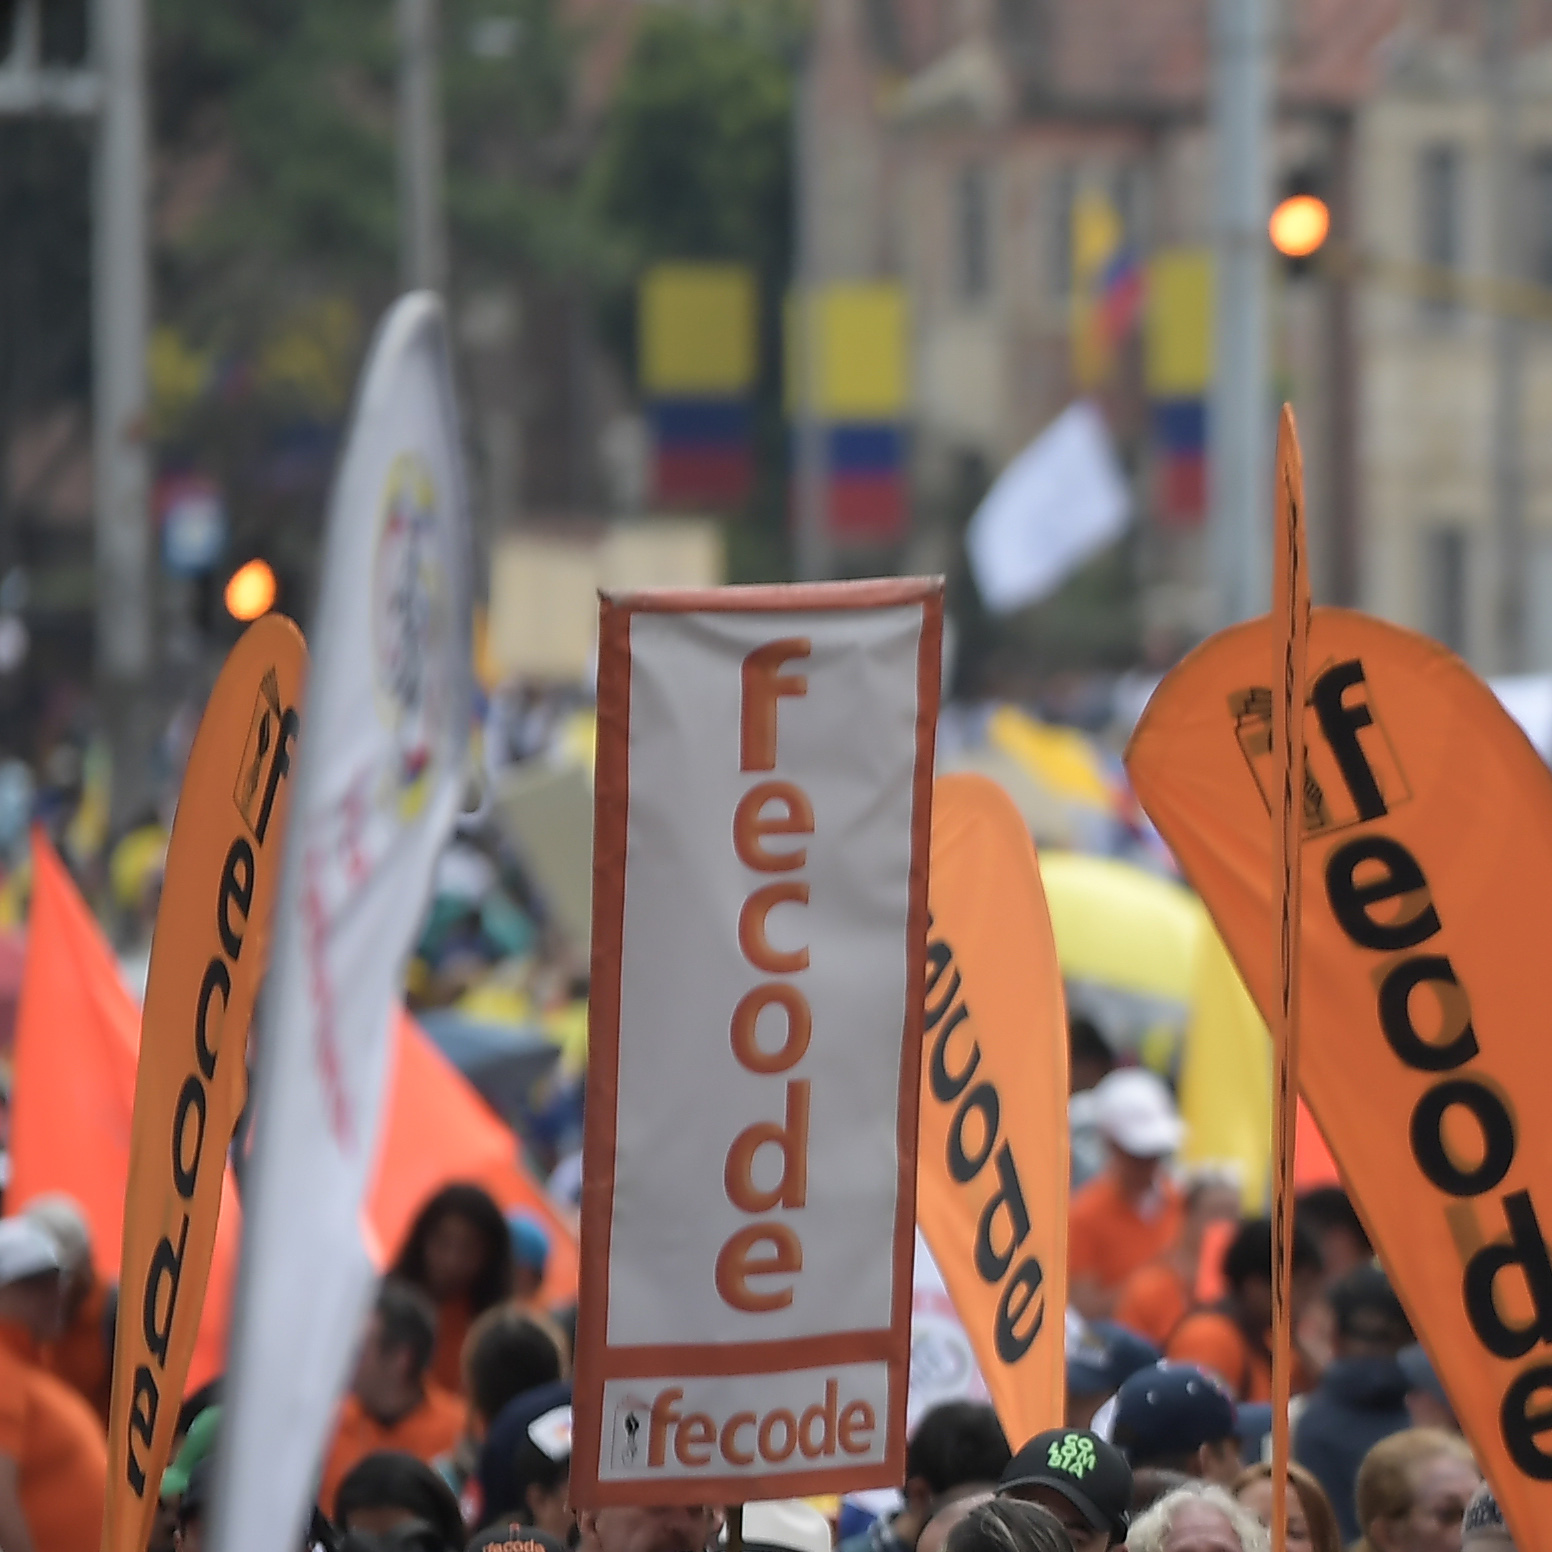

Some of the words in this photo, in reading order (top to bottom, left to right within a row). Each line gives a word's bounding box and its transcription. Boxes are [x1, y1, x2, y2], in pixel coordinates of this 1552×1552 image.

[125, 706, 299, 1498] fecode
[714, 637, 815, 1314] fecode
[925, 940, 1044, 1365] ecode
[647, 1380, 875, 1469] fecode
